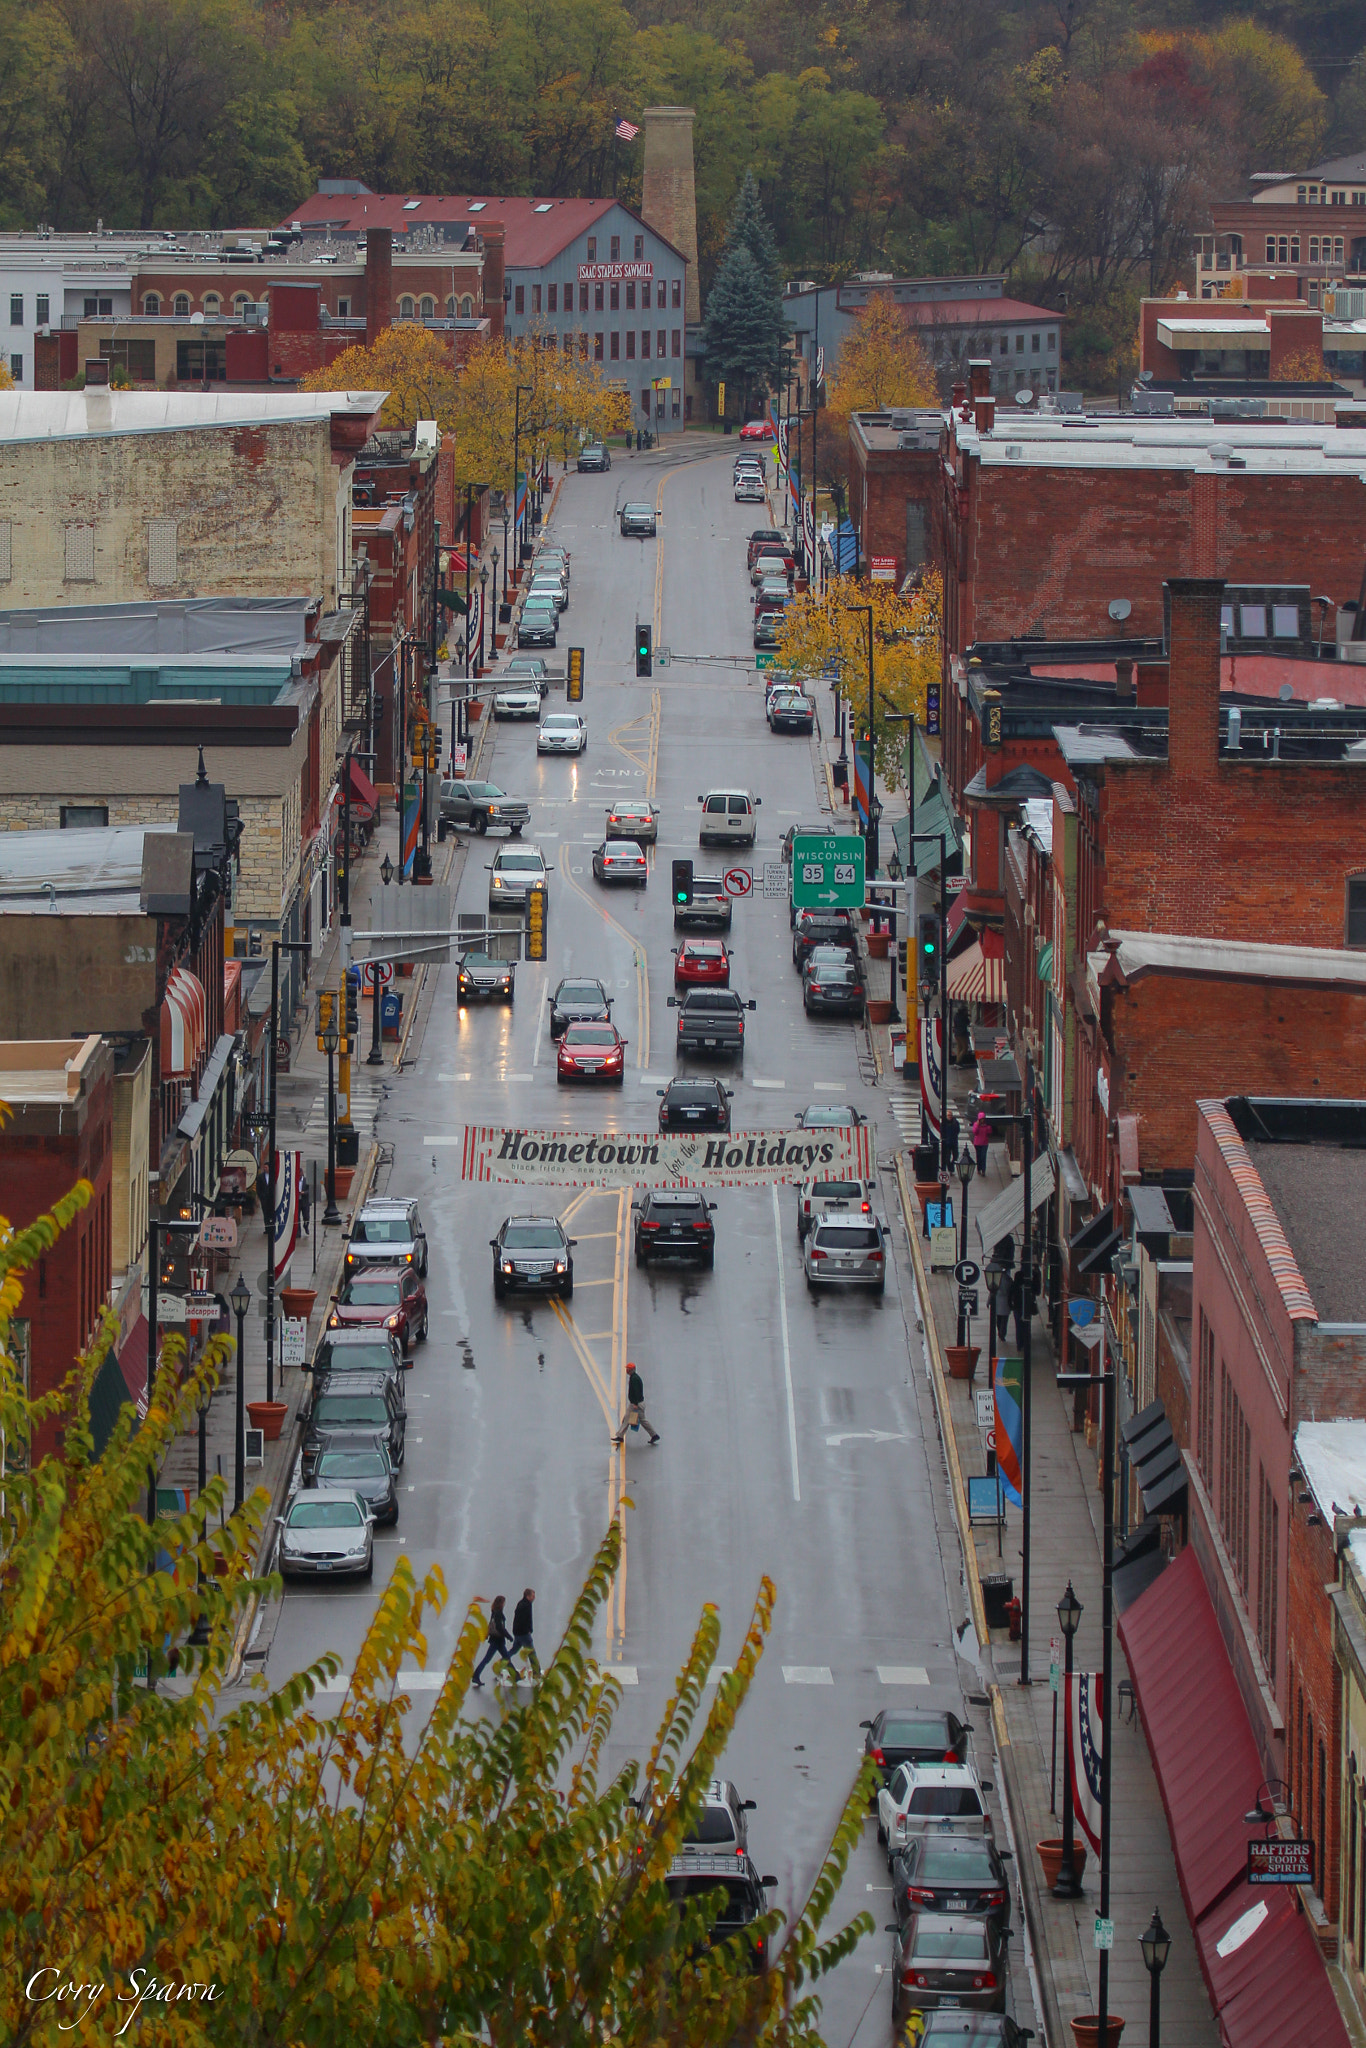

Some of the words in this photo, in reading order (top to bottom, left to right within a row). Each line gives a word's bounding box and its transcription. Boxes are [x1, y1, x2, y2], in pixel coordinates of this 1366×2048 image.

[579, 265, 597, 279] ISAAC
[624, 263, 652, 277] SAWMILL
[594, 769, 646, 777] ONLY
[823, 840, 836, 849] TO
[796, 852, 862, 861] WISCONSIN
[804, 867, 822, 880] 35
[836, 868, 853, 880] 64
[497, 1132, 660, 1165] Hometown
[664, 1157, 686, 1179] for
[680, 1141, 699, 1159] the
[702, 1138, 834, 1172] Holidays
[511, 1163, 535, 1171] black
[540, 1164, 566, 1173] friday
[577, 1166, 595, 1174] new
[598, 1167, 627, 1175] year's
[630, 1167, 647, 1176] day
[210, 1224, 226, 1233] Fun
[204, 1232, 232, 1242] Sisters
[962, 1265, 975, 1281] P
[285, 1327, 300, 1336] Fun
[1250, 1844, 1310, 1855] RAFTERS
[1268, 1855, 1297, 1864] FOOD
[1299, 1855, 1307, 1864] &
[1268, 1864, 1309, 1873] SPIRITS
